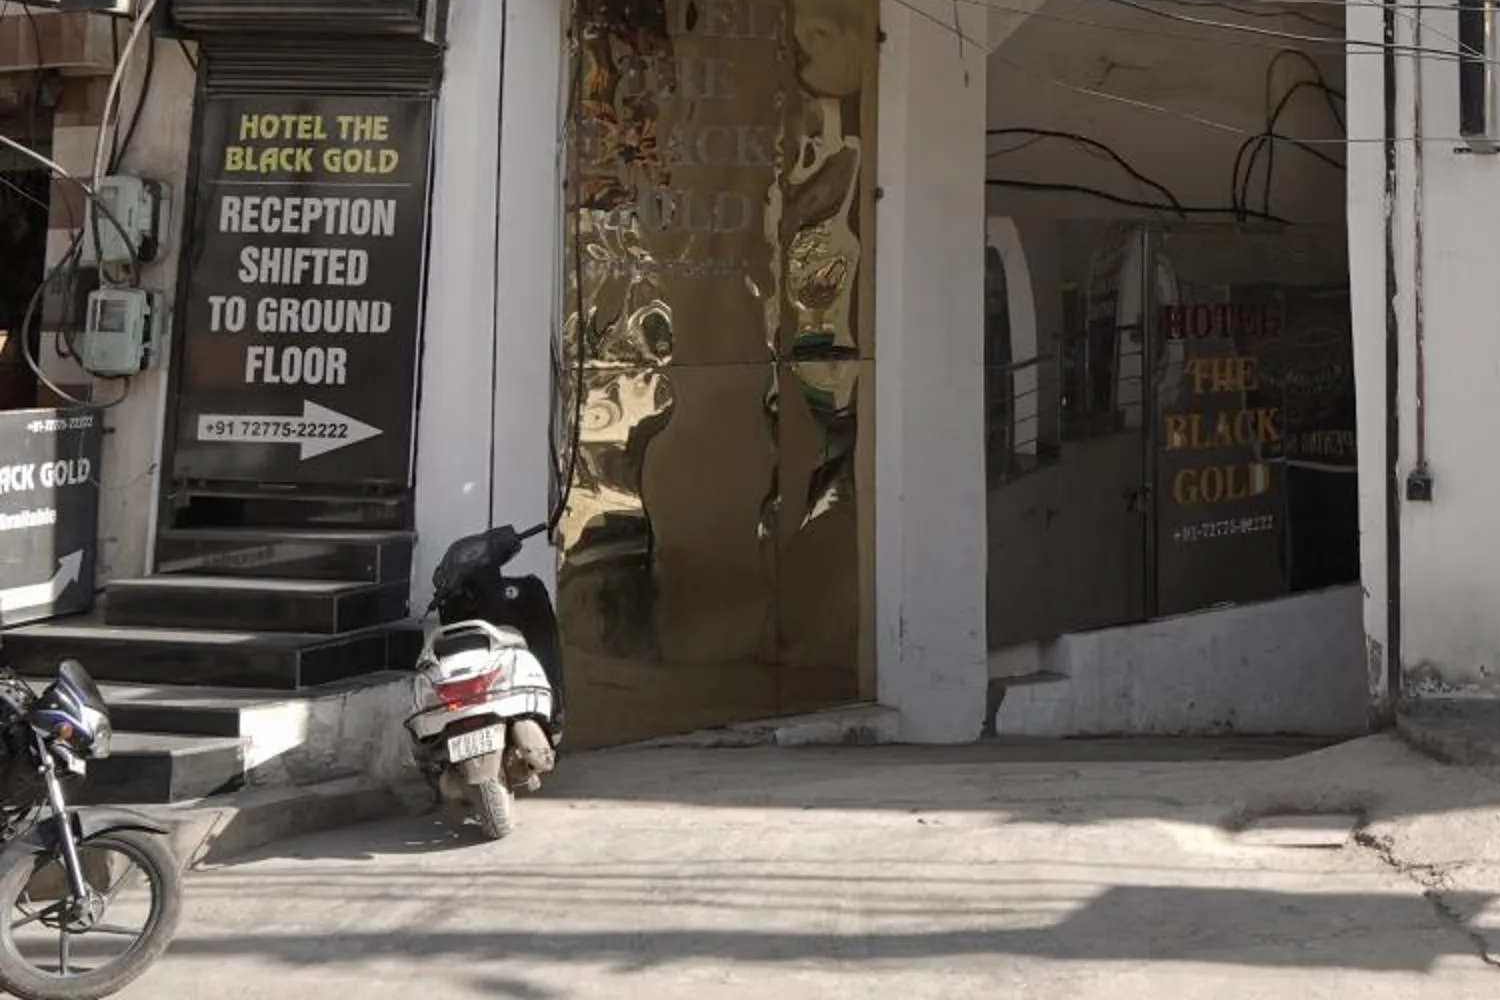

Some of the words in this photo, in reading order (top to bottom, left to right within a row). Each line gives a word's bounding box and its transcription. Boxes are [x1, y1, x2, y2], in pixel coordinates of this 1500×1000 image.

[240, 113, 328, 142] HOTEL
[337, 115, 390, 143] THE
[225, 147, 313, 174] BLACK
[323, 148, 399, 174] GOLD
[219, 195, 397, 237] RECEPTION
[238, 246, 370, 286] SHIFTED
[208, 295, 247, 333] TO
[256, 296, 392, 334] GROUND
[245, 345, 347, 385] FLOOR
[1187, 356, 1260, 394] THE
[205, 420, 235, 437] +91
[241, 420, 349, 438] 72775-22222
[1164, 408, 1282, 450] BLACK
[0, 463, 36, 494] ACK
[40, 458, 92, 488] GOLD
[1172, 463, 1272, 505] GOLD
